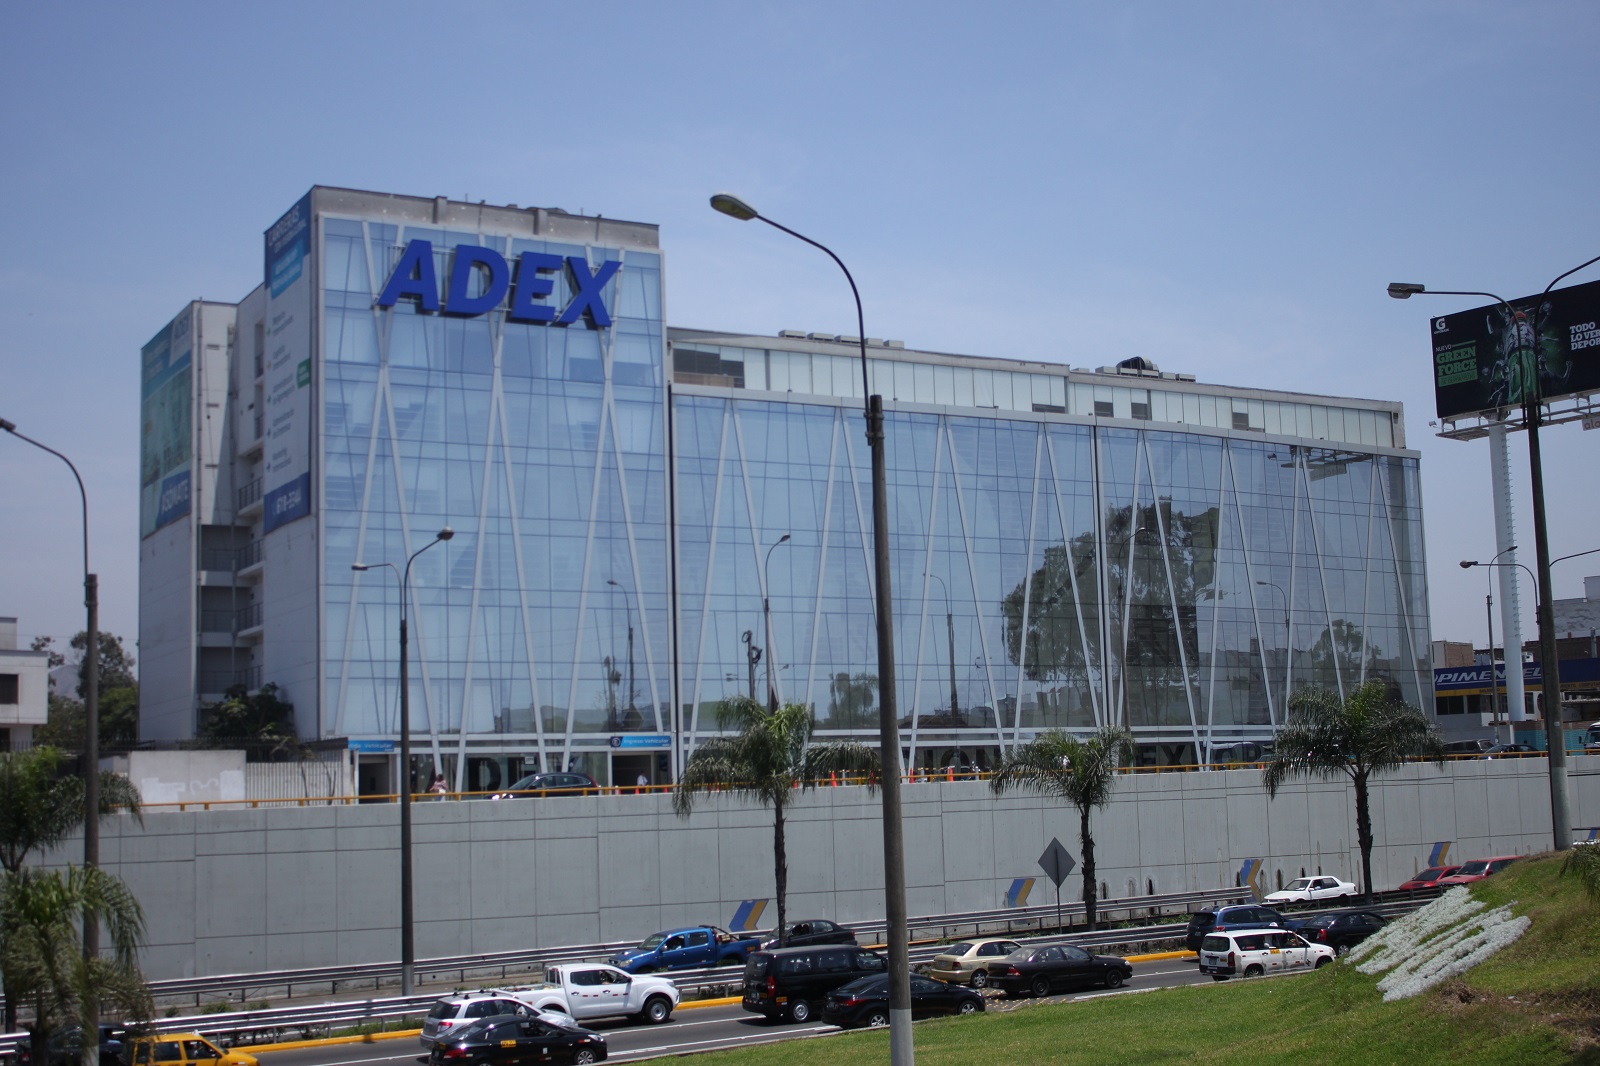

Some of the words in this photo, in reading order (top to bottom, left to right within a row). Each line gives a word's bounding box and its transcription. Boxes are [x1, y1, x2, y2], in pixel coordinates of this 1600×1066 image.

[375, 239, 622, 328] ADEX
[1570, 321, 1596, 334] TODO
[1570, 333, 1583, 342] LO
[1435, 343, 1452, 352] NUEVO
[1436, 346, 1477, 364] GREEN
[1437, 358, 1478, 377] FORCE
